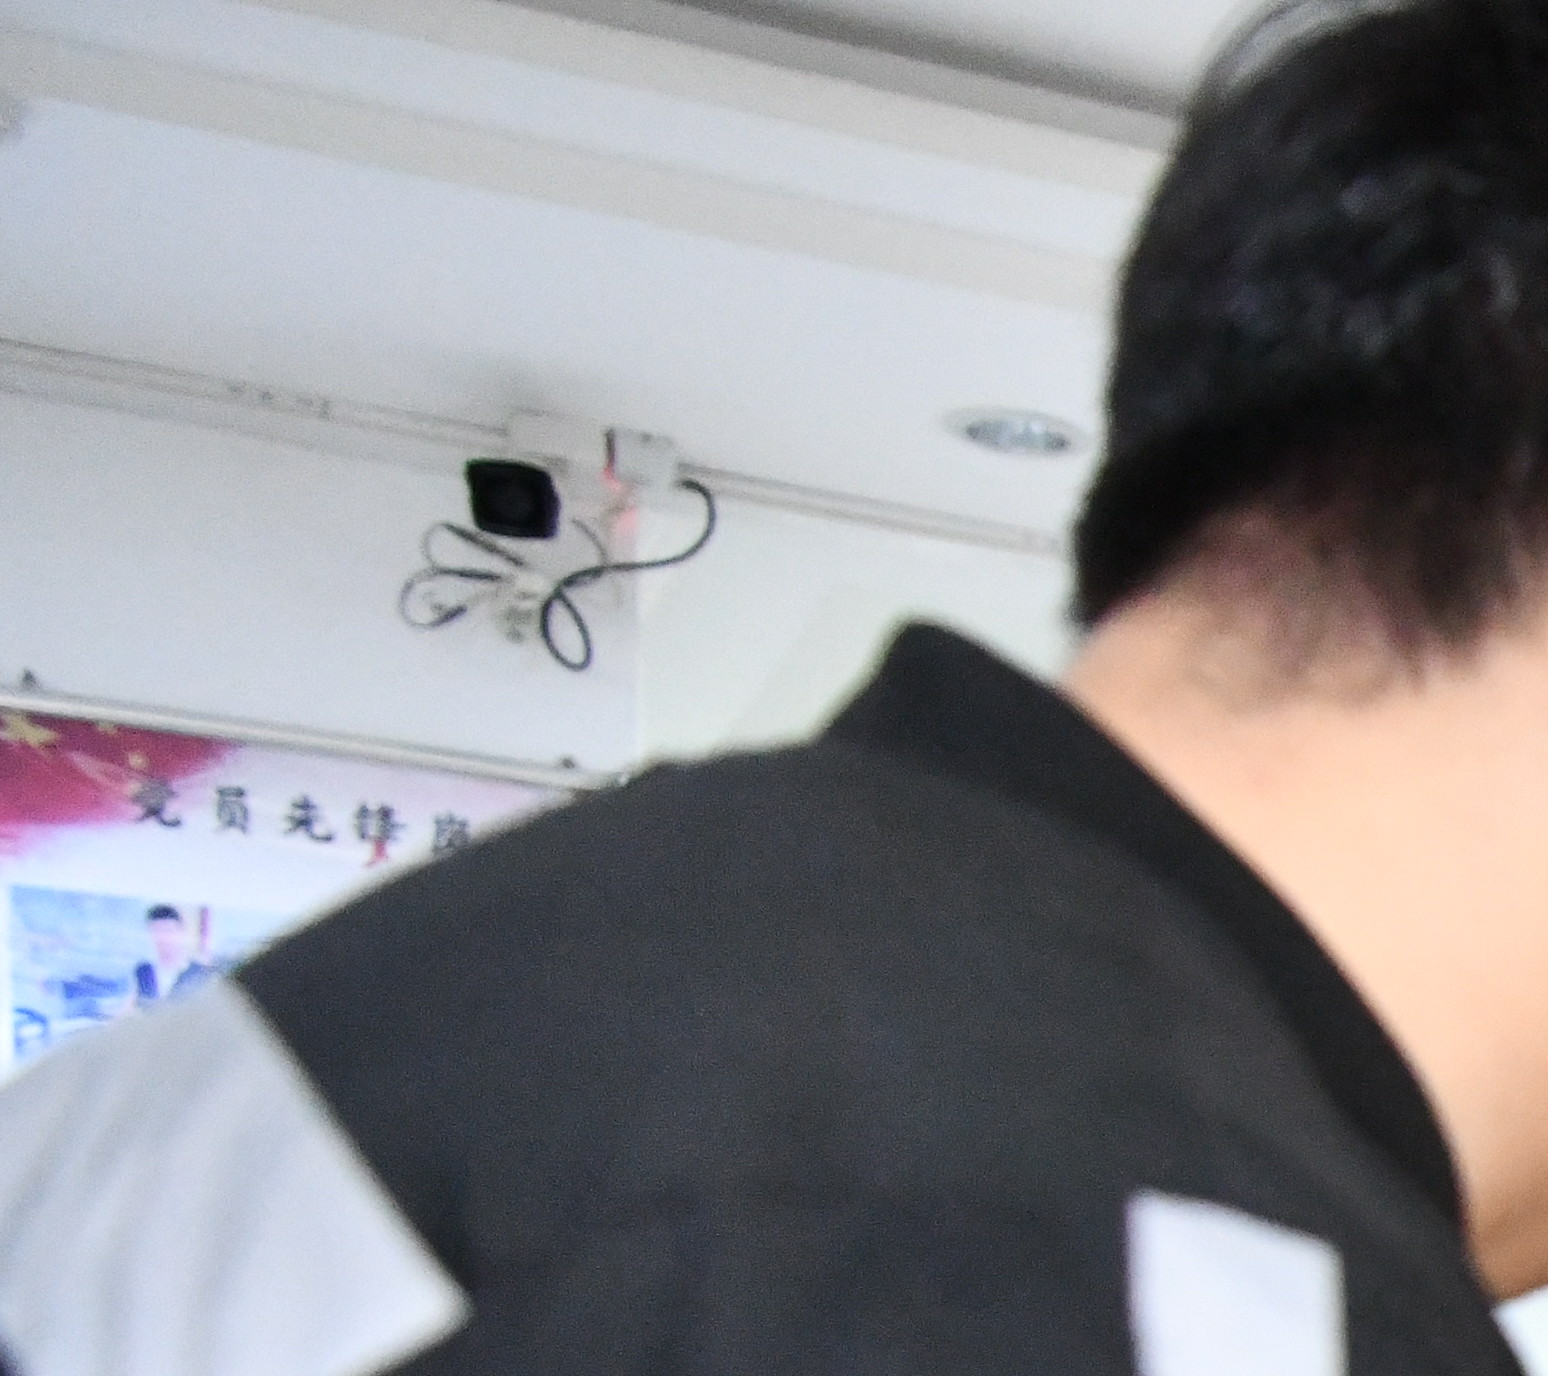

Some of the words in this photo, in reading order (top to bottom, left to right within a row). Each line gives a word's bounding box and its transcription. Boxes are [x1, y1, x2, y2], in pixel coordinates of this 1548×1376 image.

[132, 779, 471, 857] 党员先锋岗
